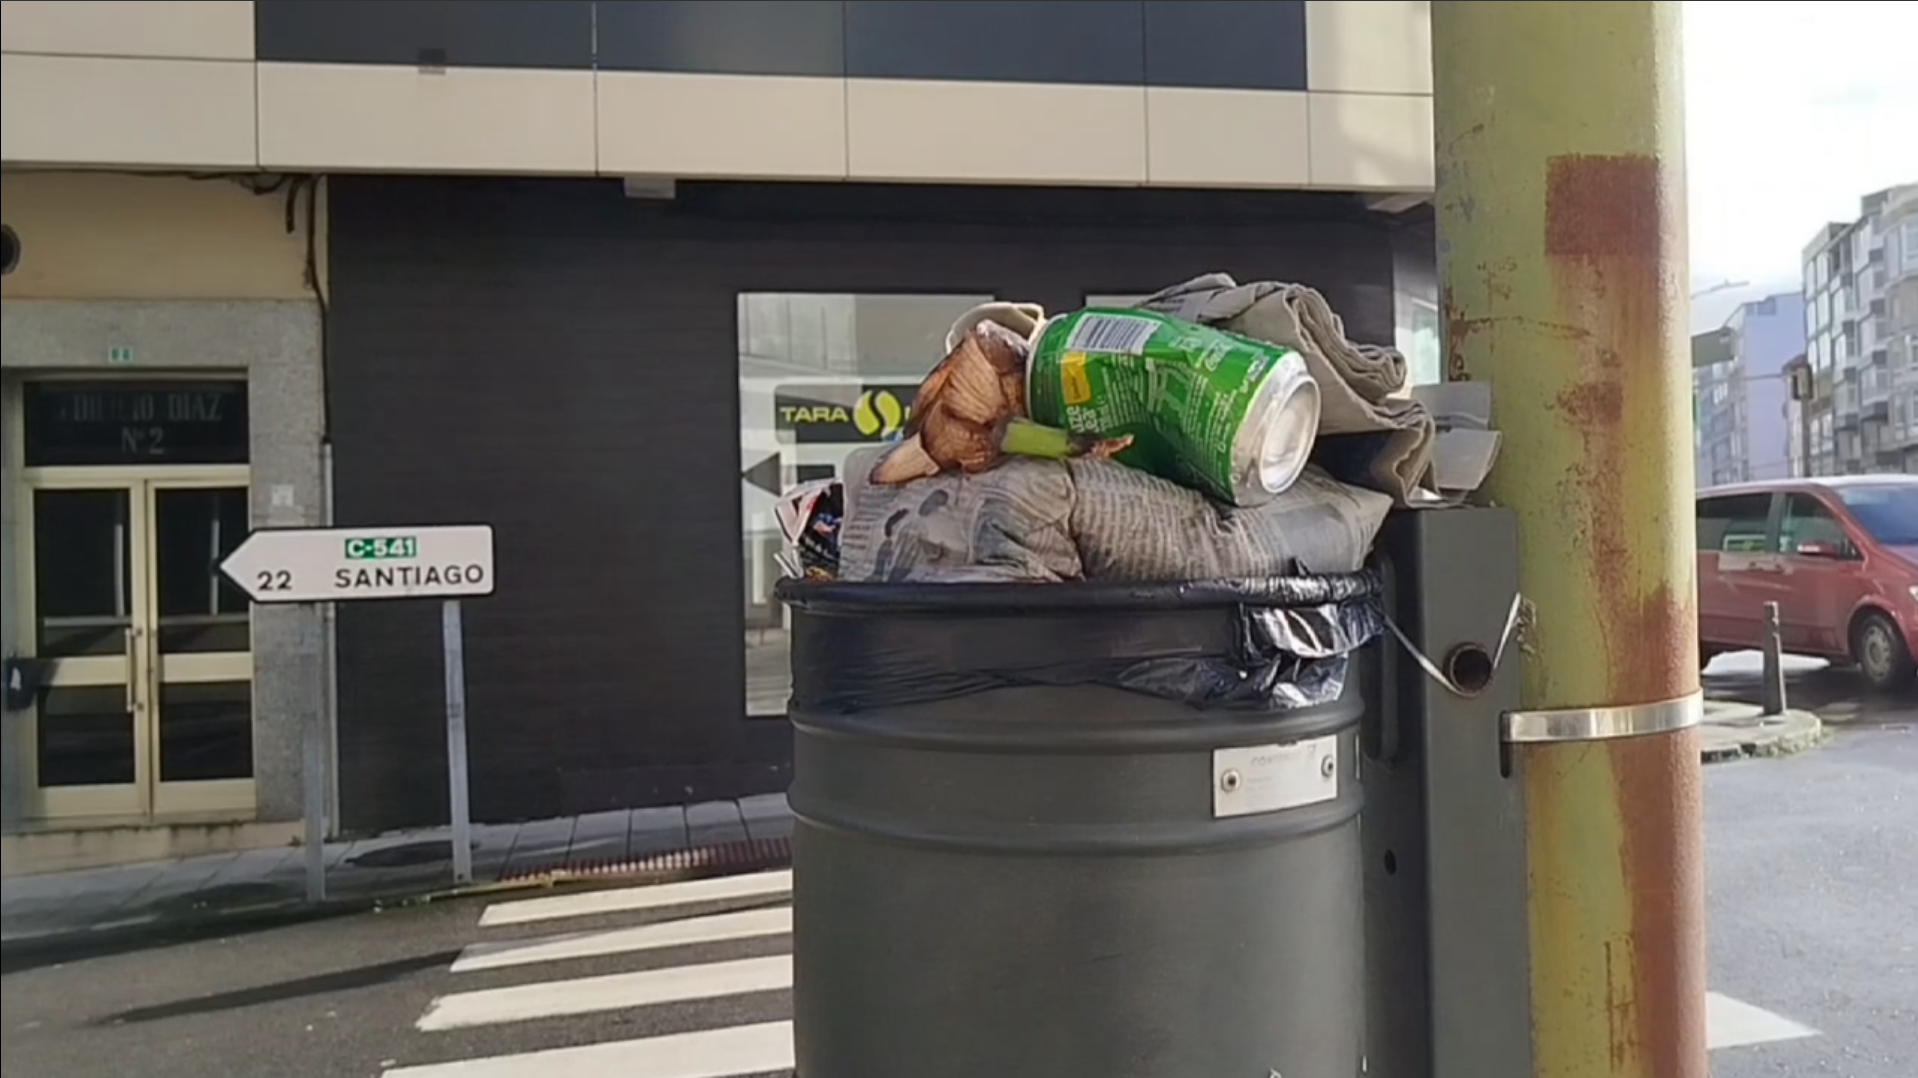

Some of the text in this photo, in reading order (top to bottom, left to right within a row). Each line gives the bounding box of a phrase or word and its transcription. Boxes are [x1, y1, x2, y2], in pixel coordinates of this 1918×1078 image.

[167, 393, 222, 421] DIAZ
[780, 406, 849, 422] TARA
[148, 427, 164, 455] 2
[348, 538, 415, 557] C-541
[257, 564, 484, 591] 22 SANTIAGO
